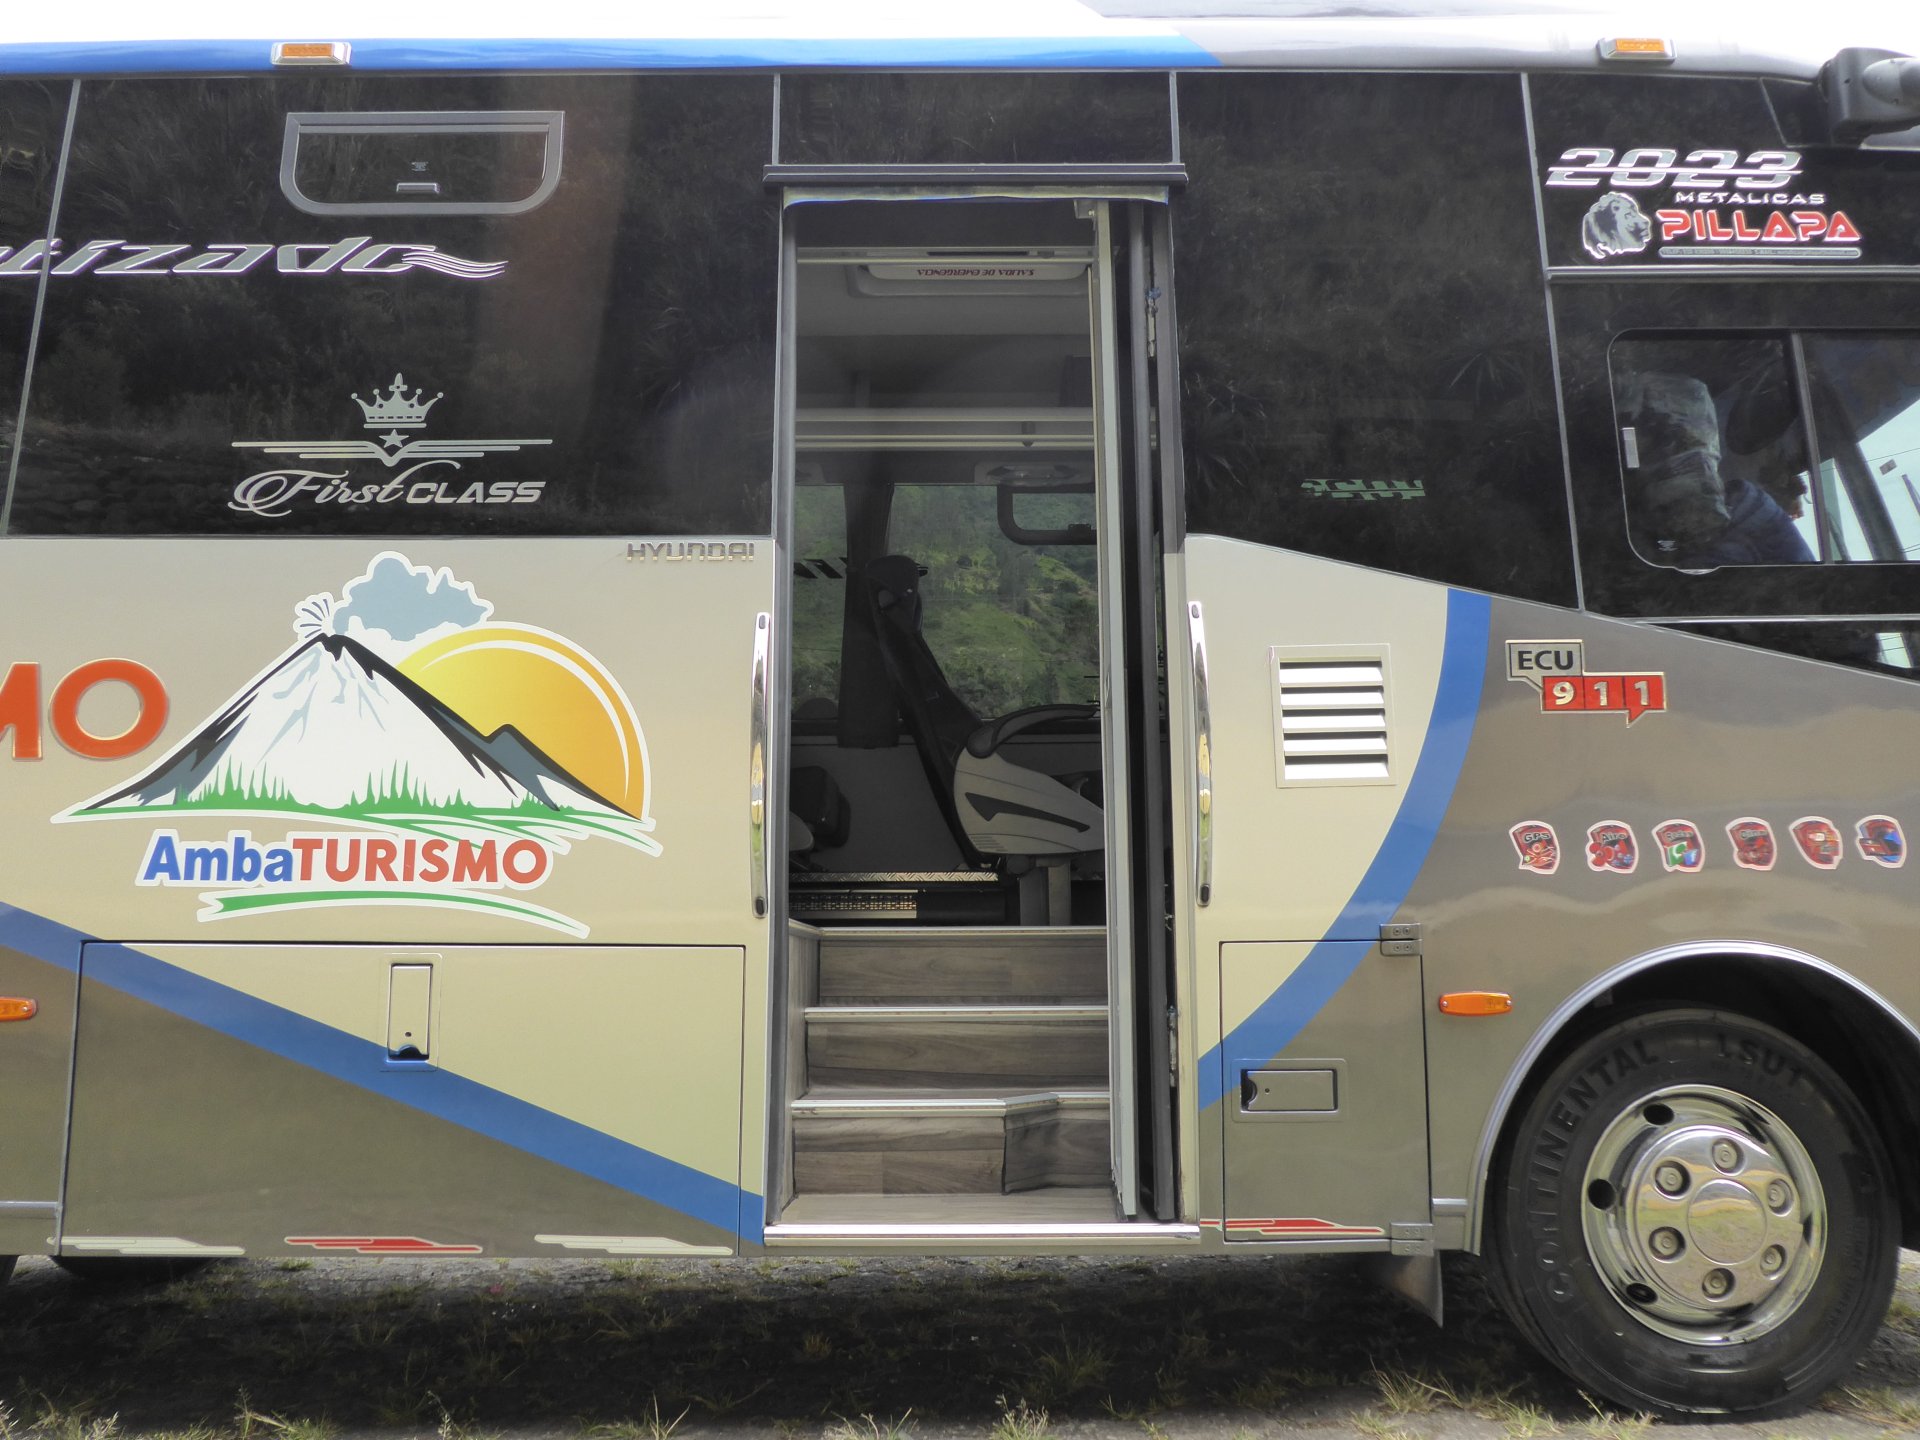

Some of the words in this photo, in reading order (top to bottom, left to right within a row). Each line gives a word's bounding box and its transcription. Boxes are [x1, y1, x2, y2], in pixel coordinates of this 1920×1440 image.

[1545, 148, 1803, 190] 2023
[1674, 192, 1826, 205] METALICAS
[1656, 209, 1861, 242] PILLAPA
[916, 268, 981, 277] EMERGENCIA
[981, 269, 996, 277] DE
[999, 269, 1035, 277] SALIDA
[228, 460, 462, 517] First
[406, 482, 546, 504] CLASS
[626, 542, 755, 561] HYUNDAI
[1517, 649, 1574, 671] ECU
[1552, 680, 1649, 707] 911
[1523, 832, 1551, 844] GPS
[142, 835, 548, 884] AmbaTURISMO
